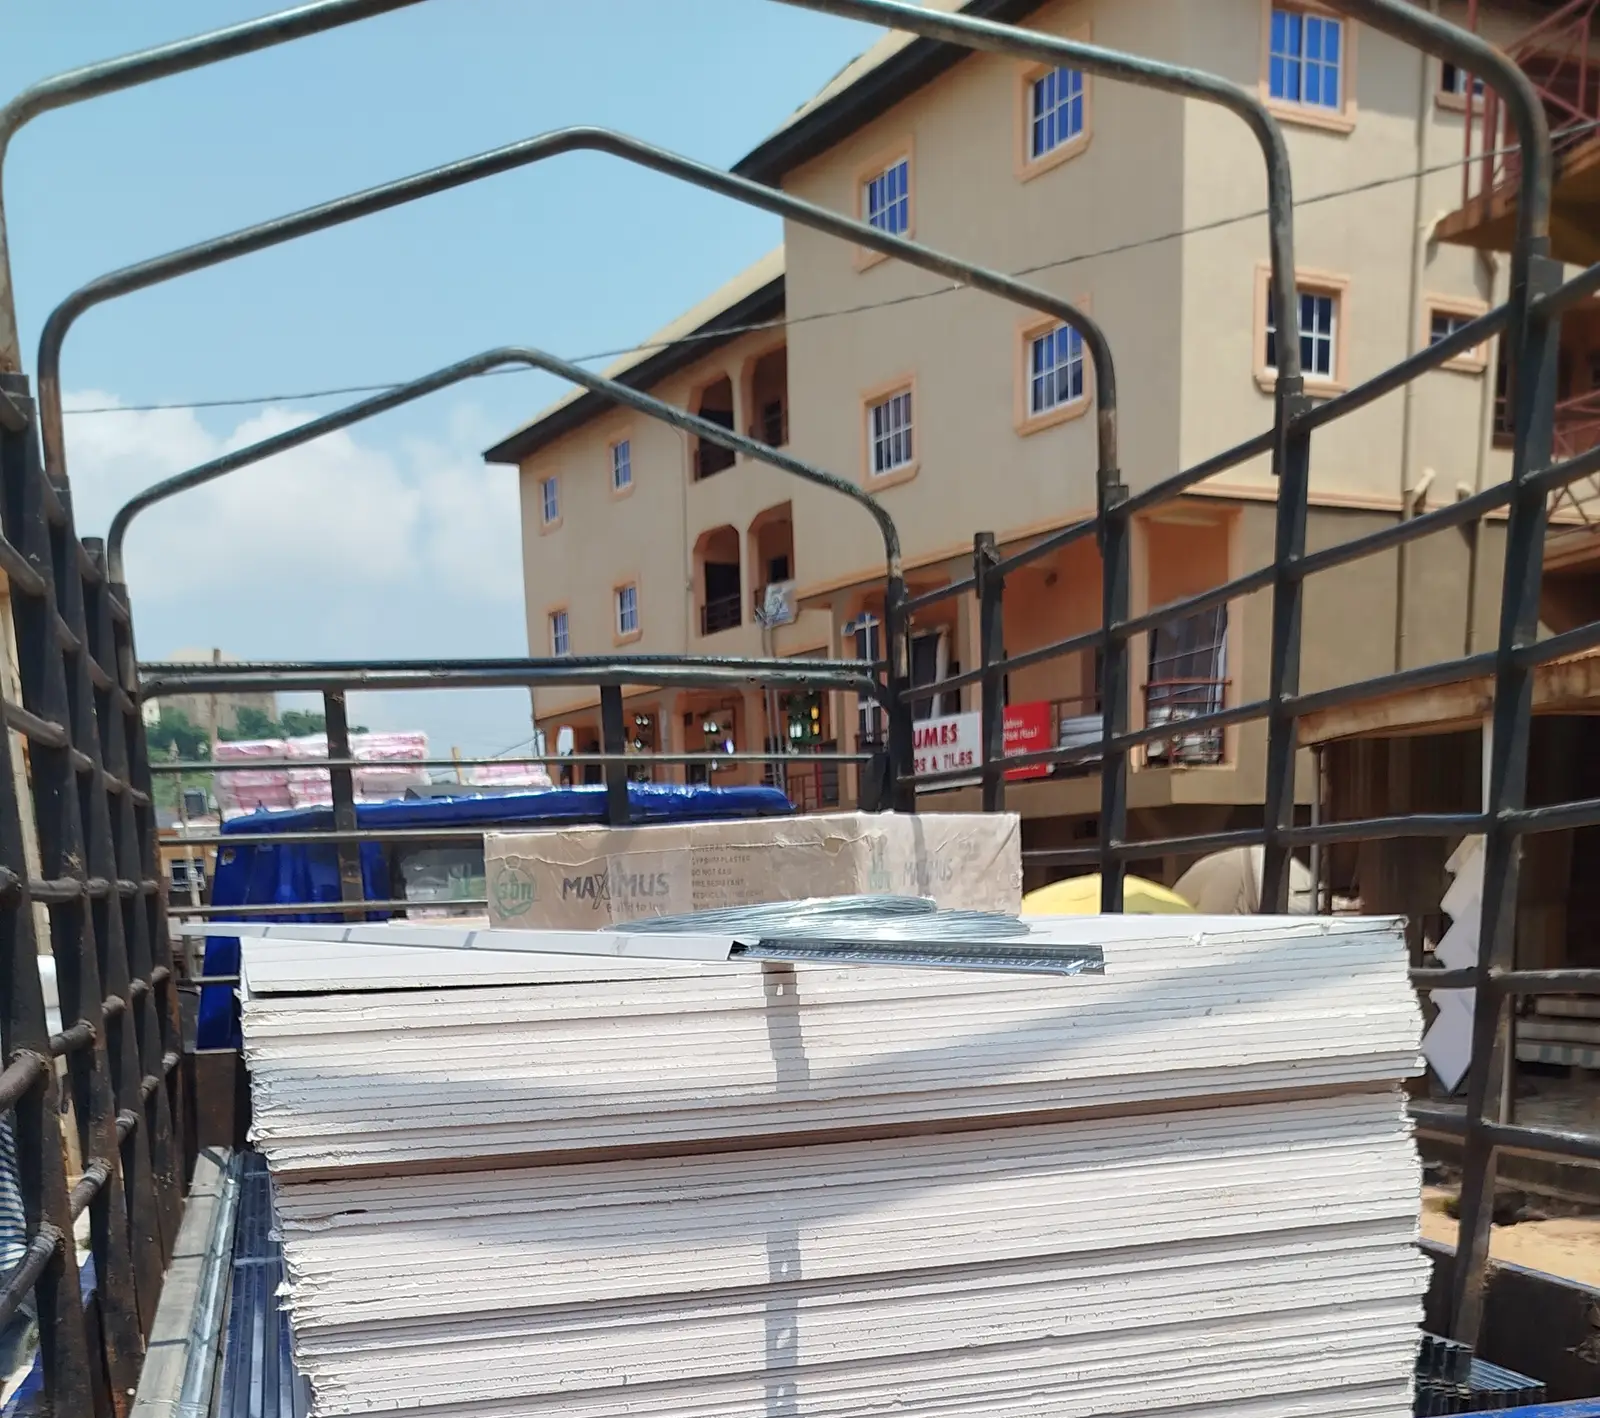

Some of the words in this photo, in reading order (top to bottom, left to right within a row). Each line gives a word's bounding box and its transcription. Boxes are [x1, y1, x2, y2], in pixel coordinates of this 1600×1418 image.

[943, 750, 973, 769] TILES
[702, 868, 716, 877] NOT
[562, 862, 671, 910] MAXIMUS
[636, 901, 647, 912] to
